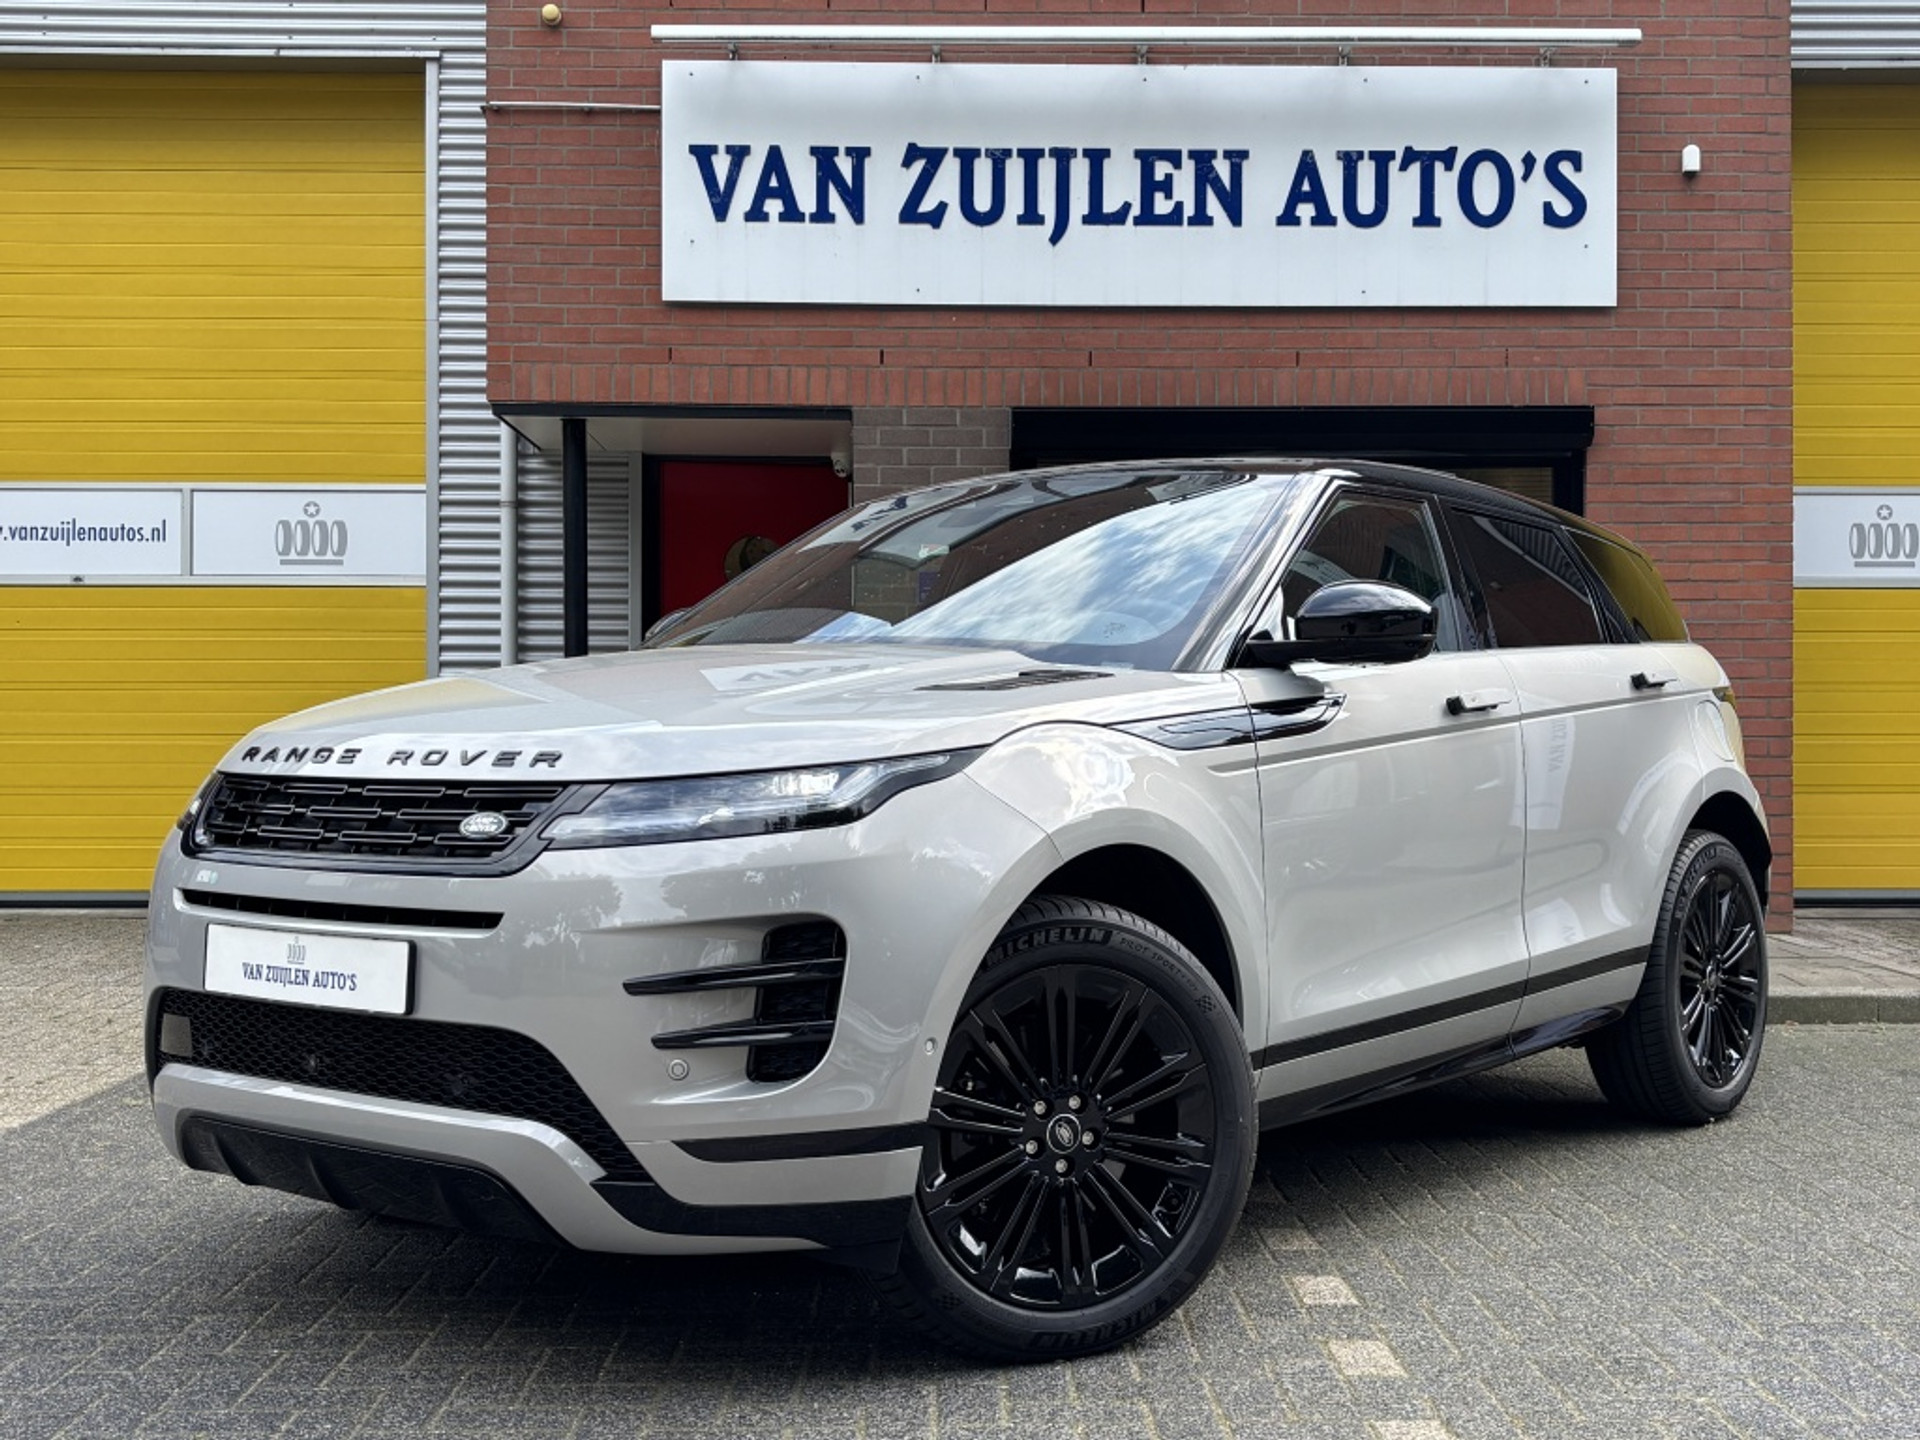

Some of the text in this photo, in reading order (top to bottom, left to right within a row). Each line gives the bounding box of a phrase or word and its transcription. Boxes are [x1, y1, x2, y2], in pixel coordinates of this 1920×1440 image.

[688, 142, 1588, 247] VAN ZUIJLEN AUTO'S
[0, 517, 167, 547] .vanzuijlenautos.nl
[241, 746, 563, 768] RANGE ROVER
[985, 926, 1106, 968] MICHELIN
[241, 962, 358, 991] VAN ZUIJLEN AUTO'S
